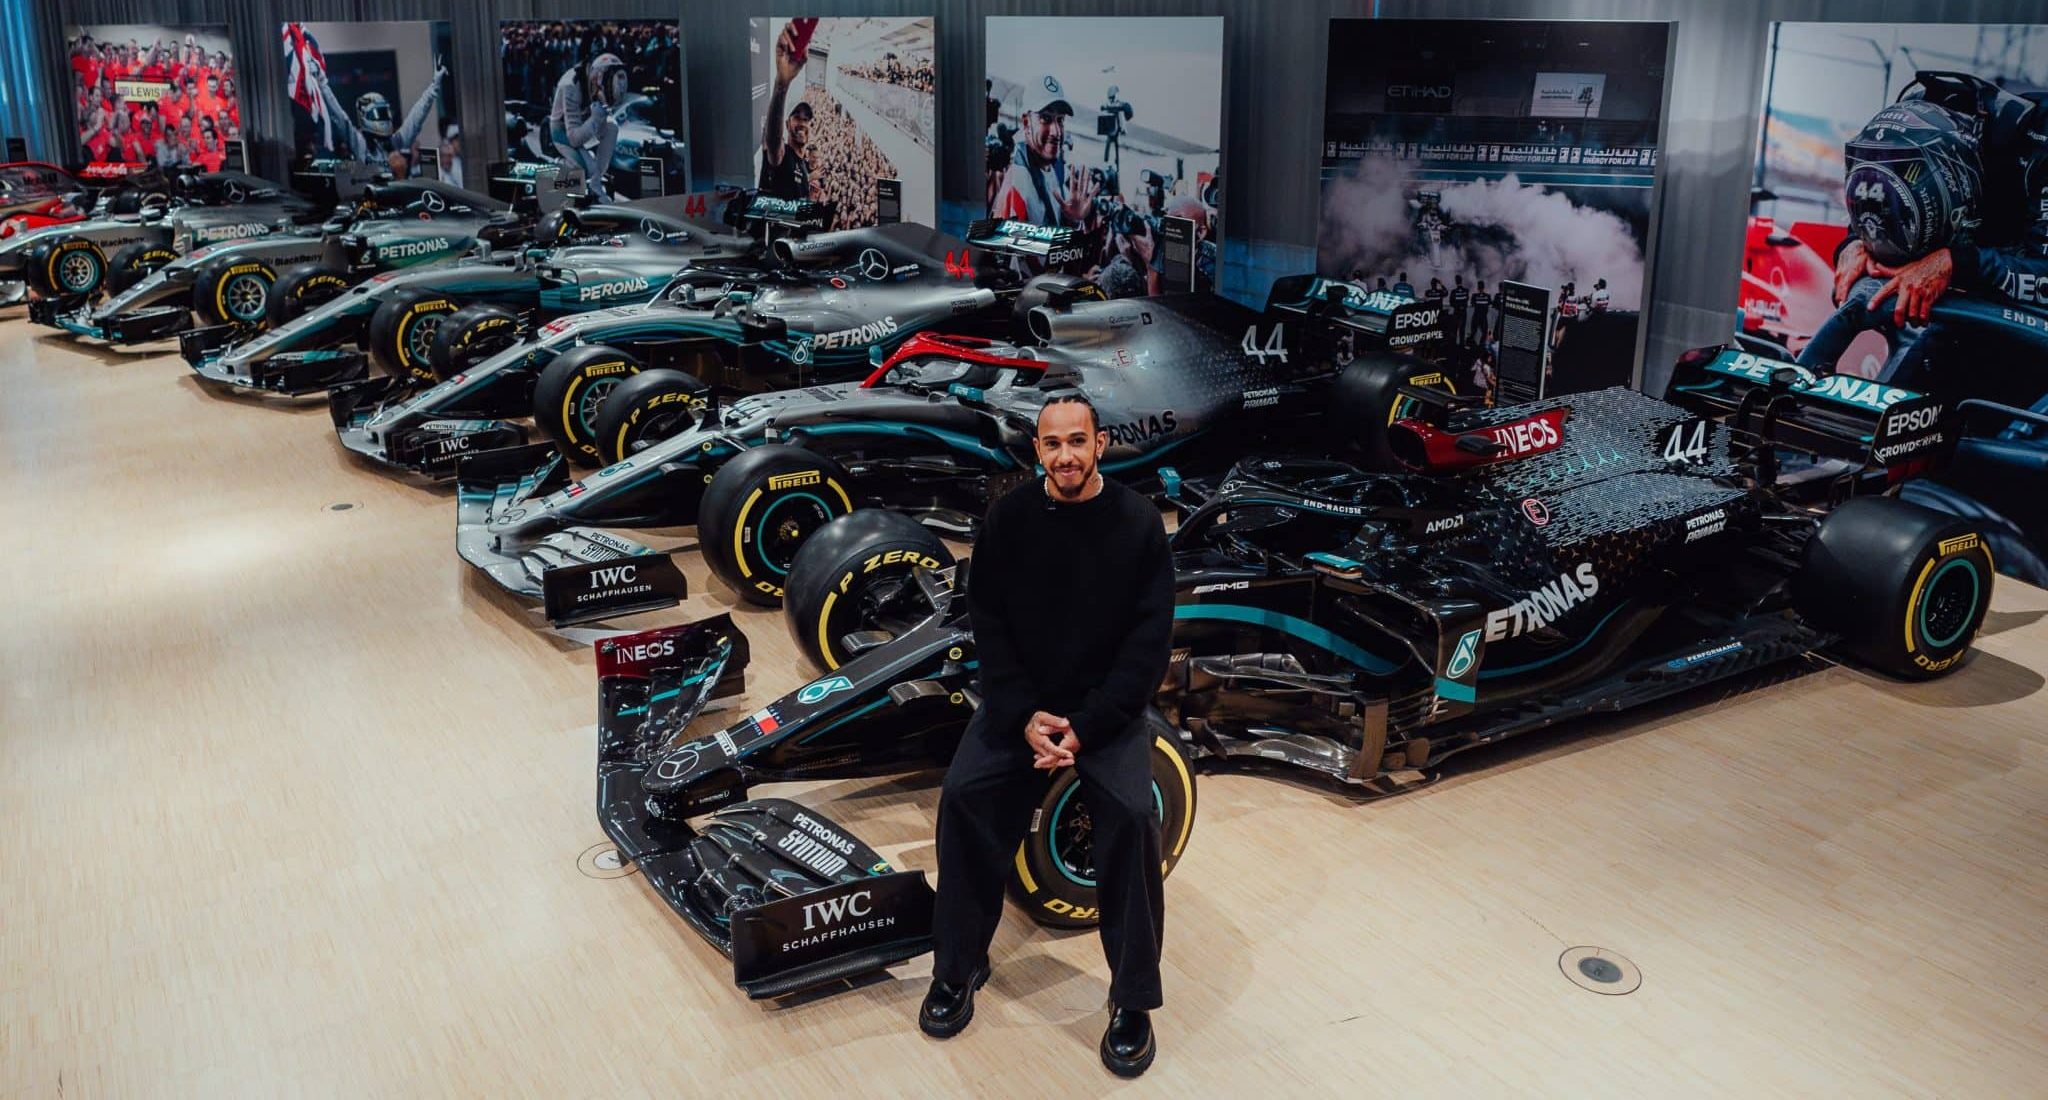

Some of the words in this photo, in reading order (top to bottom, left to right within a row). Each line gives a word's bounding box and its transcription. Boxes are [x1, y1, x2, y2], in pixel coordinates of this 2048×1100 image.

[131, 86, 160, 97] LEWIS
[1387, 85, 1451, 98] ETIHAD
[1855, 181, 1885, 201] 44
[685, 195, 706, 219] 44
[197, 222, 269, 241] PETRONAS
[380, 238, 449, 259] PETRONAS
[1050, 248, 1084, 264] EPSON
[944, 249, 976, 280] 44
[1395, 310, 1440, 329] EPSON
[2003, 309, 2037, 327] END
[813, 315, 898, 350] PETRONAS
[1241, 322, 1288, 365] 44
[1389, 331, 1443, 346] CROWDSTRIKE
[586, 361, 626, 378] PIRELLI
[648, 393, 708, 410] ZERO
[1242, 388, 1279, 399] PETRONAS
[1886, 405, 1944, 437] EPSON
[440, 437, 470, 454] IWC
[1493, 418, 1558, 458] INEOS
[1663, 420, 1708, 465] 44
[768, 469, 821, 491] PIRELLI
[1326, 503, 1362, 515] RACISM
[1686, 508, 1726, 530] PETRONAS
[1425, 515, 1456, 533] AMD
[590, 532, 630, 552] PETRONAS
[1938, 533, 1978, 556] PIRELLI
[863, 550, 940, 575] ZERO
[589, 565, 637, 589] IWC
[839, 571, 854, 594] P
[577, 584, 652, 603] SCHAFFHAUSEN
[1485, 562, 1600, 643] ETRONAS
[616, 639, 675, 664] INEOS
[792, 812, 855, 857] PETRONAS
[777, 829, 849, 877] SYNTIUM
[803, 890, 873, 931] IWC
[782, 915, 897, 953] SCHAFFHAUSEN
